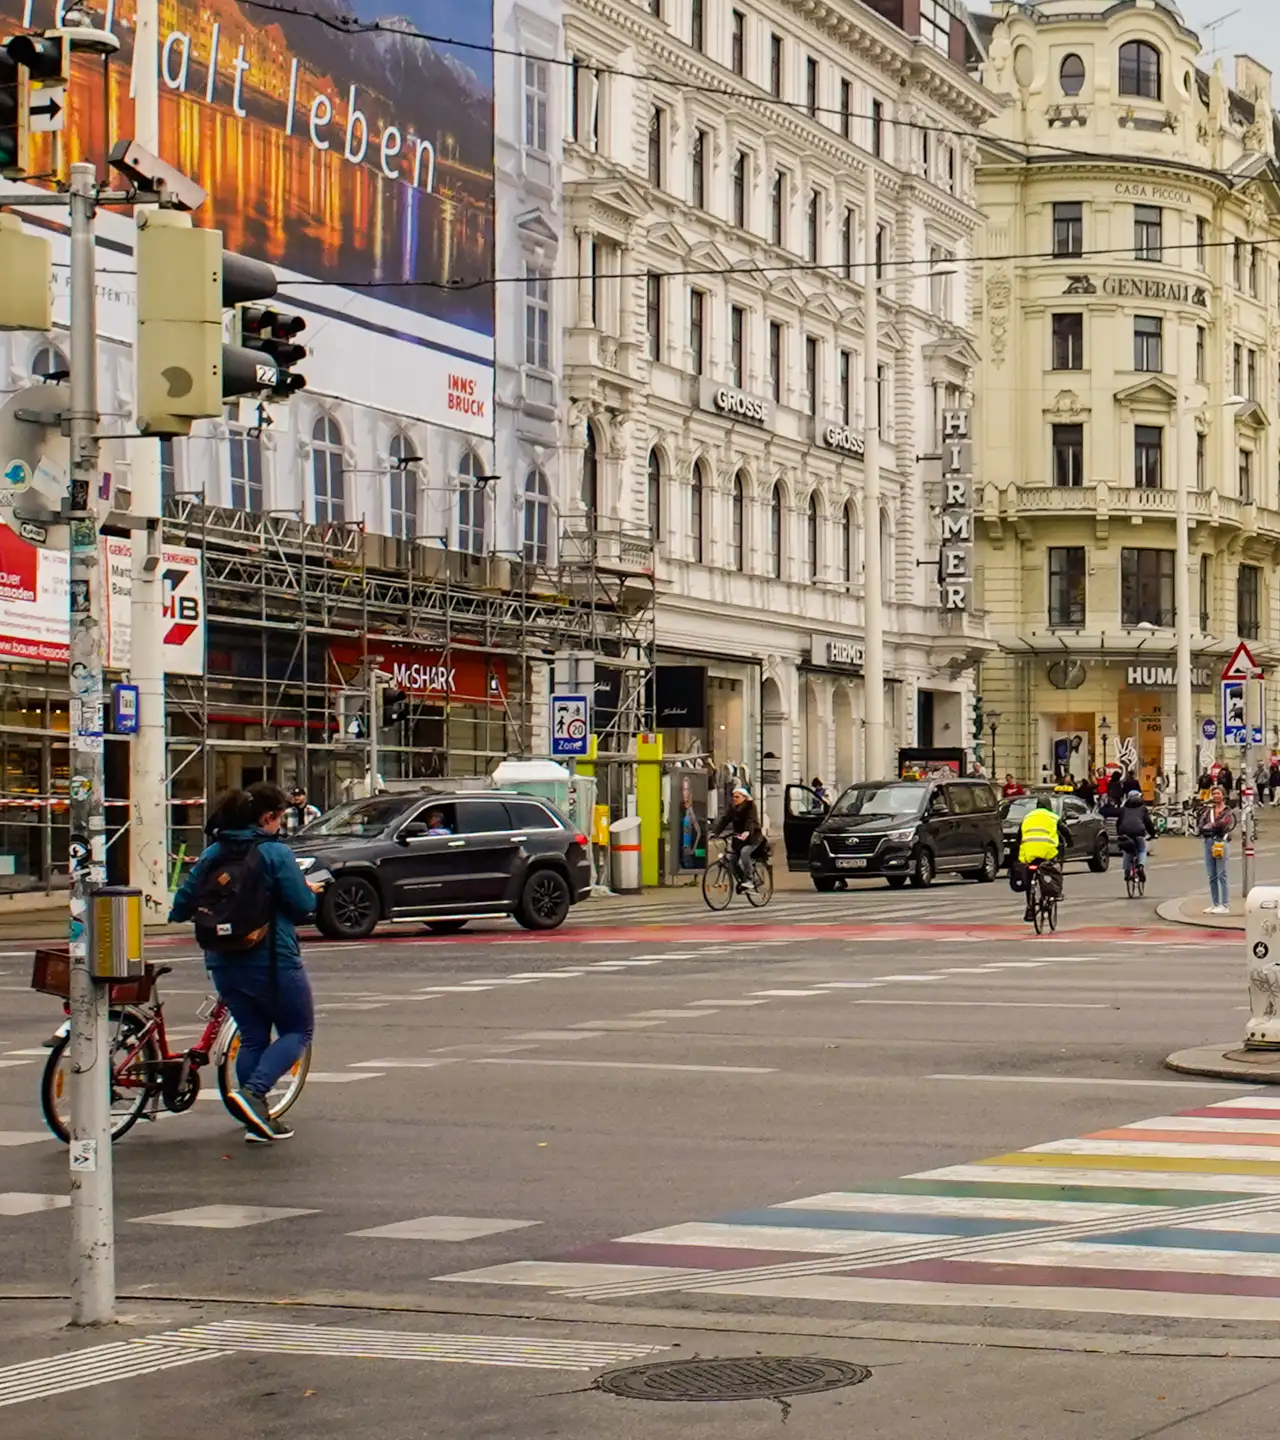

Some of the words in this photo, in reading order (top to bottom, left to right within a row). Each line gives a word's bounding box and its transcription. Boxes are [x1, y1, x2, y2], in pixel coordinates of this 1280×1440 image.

[285, 57, 436, 193] leben
[1115, 183, 1147, 197] CASA
[1152, 187, 1192, 204] PICCOLA
[1103, 277, 1189, 303] GENERALI
[258, 366, 276, 384] 22
[448, 392, 484, 417] BRUCK
[716, 387, 769, 421] GROSSE
[826, 425, 865, 453] GRÖSS
[943, 410, 969, 610] HIRMER
[830, 641, 865, 663] HIRME
[393, 662, 456, 691] McSHARK
[121, 696, 134, 709] Taxi
[572, 724, 584, 736] 20
